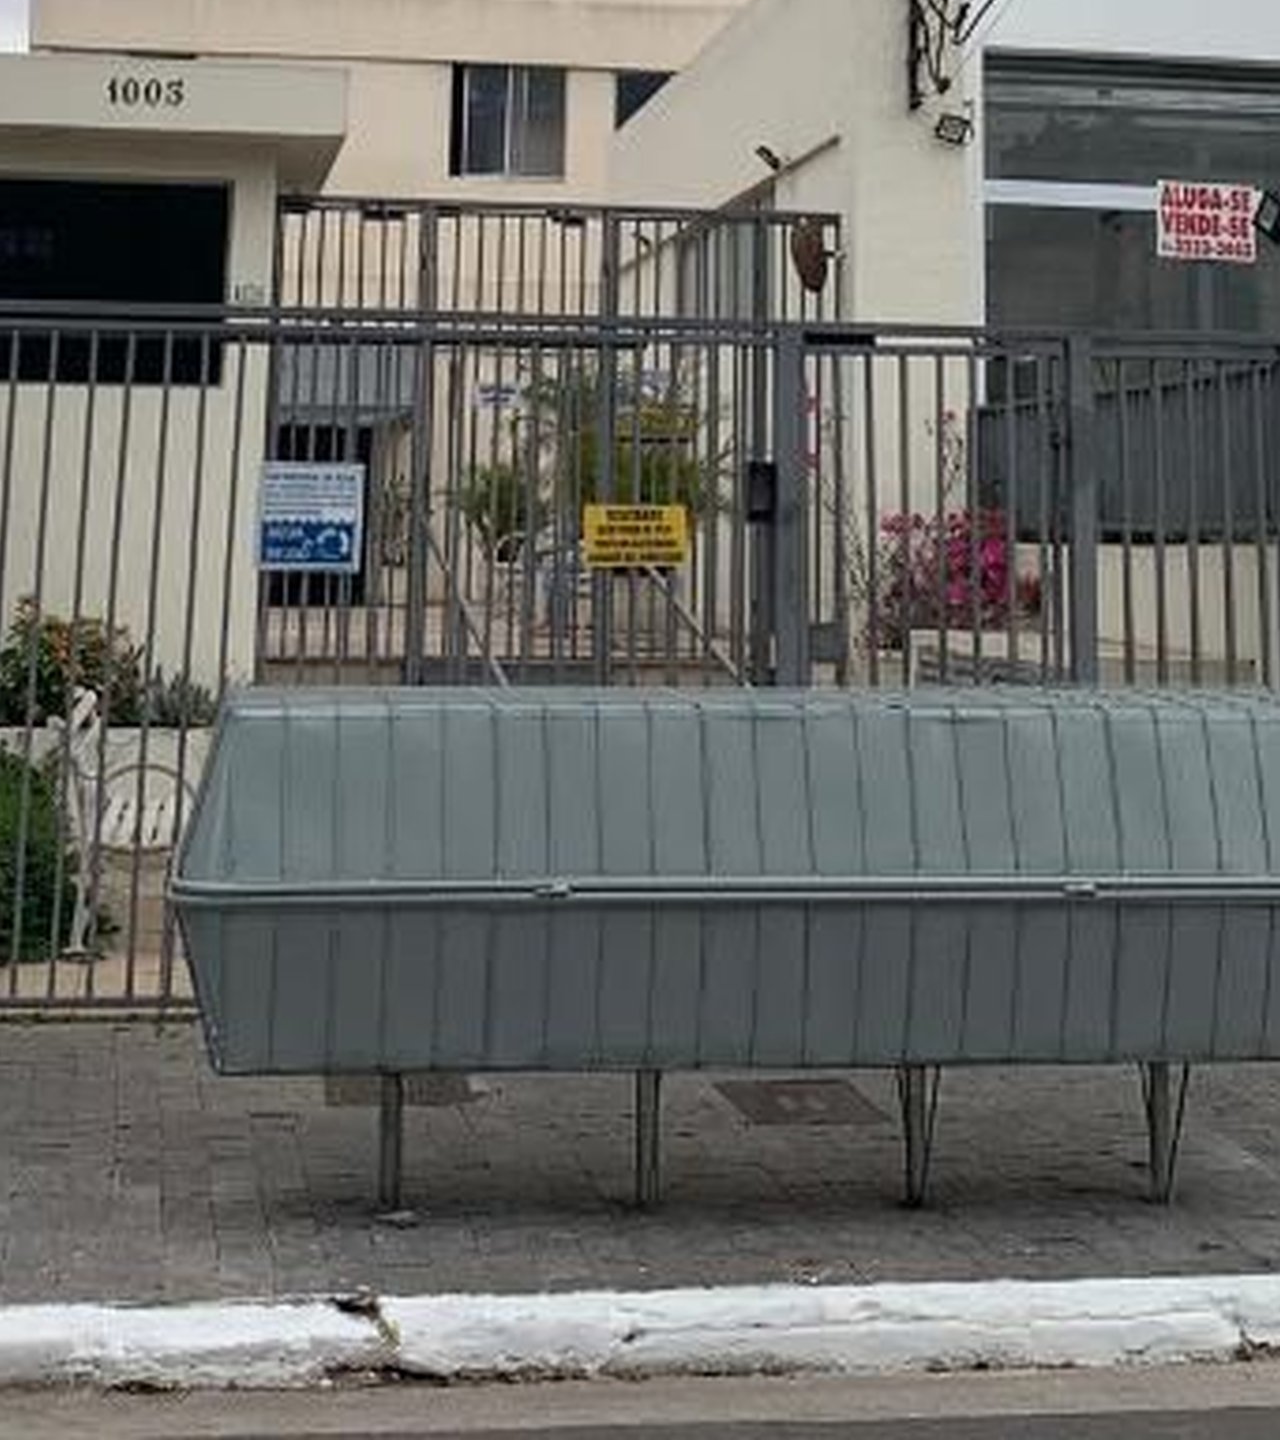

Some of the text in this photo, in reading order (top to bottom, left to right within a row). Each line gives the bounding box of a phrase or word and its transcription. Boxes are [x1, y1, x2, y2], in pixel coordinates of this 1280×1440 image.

[107, 77, 185, 107] 1003
[1161, 185, 1251, 213] ALUGA-SE
[1161, 212, 1250, 239] VENDE-SE
